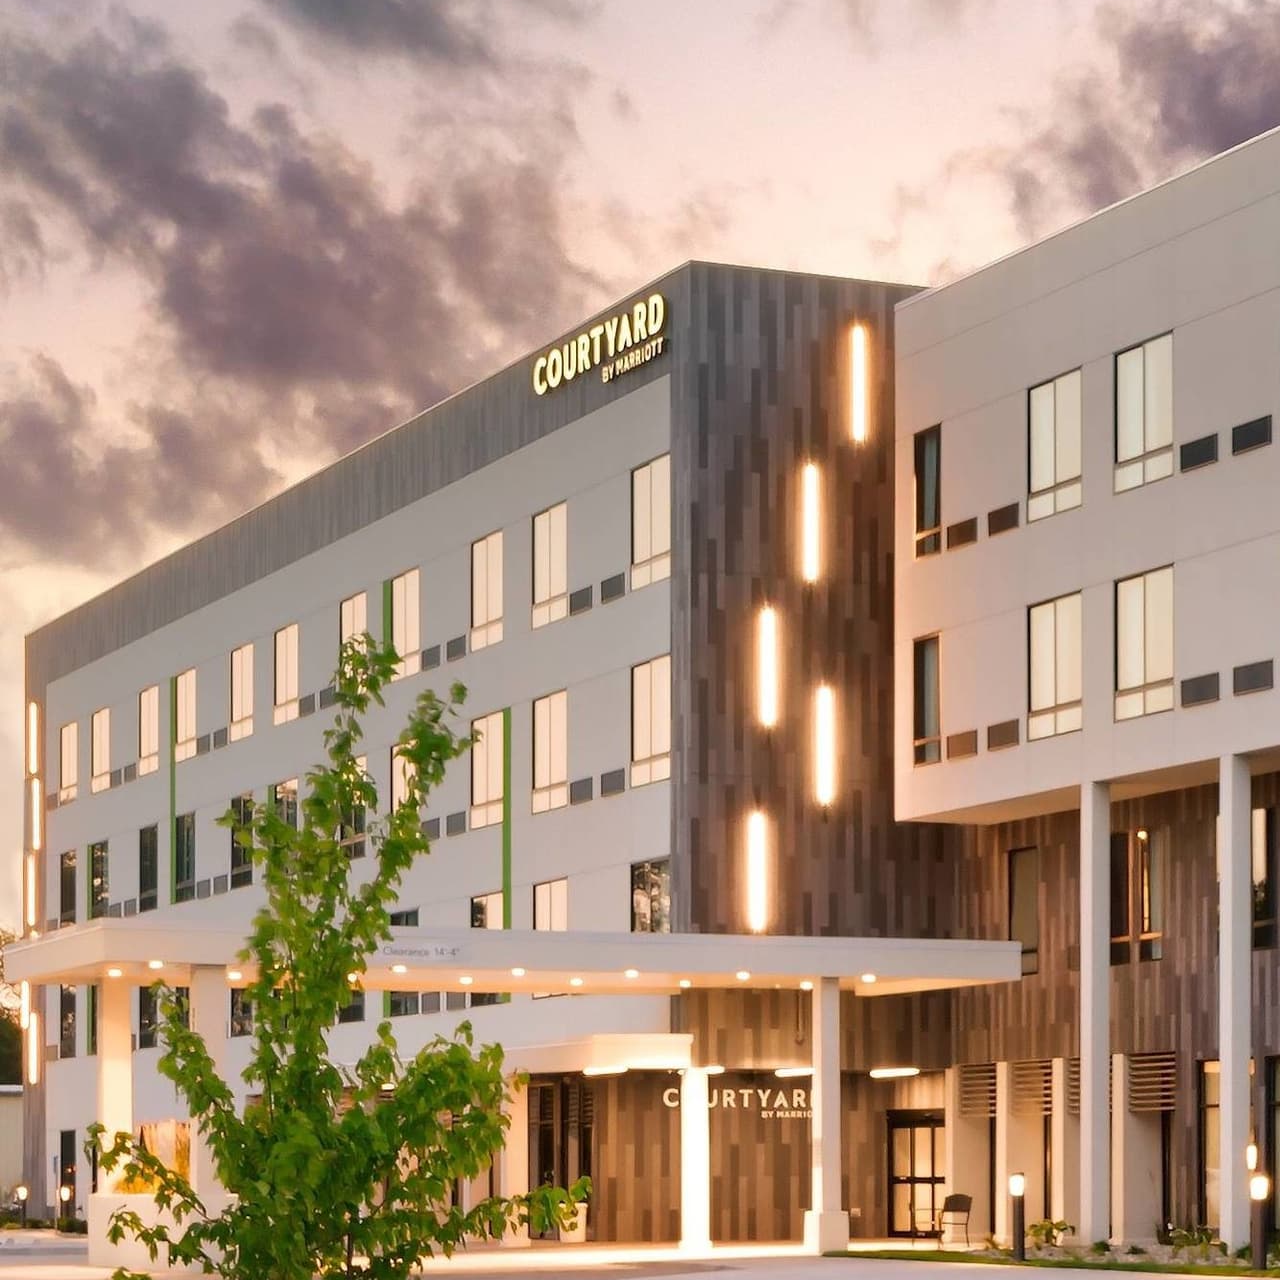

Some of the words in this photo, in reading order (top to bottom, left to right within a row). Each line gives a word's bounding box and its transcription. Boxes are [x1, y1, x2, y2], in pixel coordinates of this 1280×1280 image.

[533, 293, 665, 396] COURTYARD
[602, 363, 616, 384] BY
[615, 336, 664, 377] MARRIOTT
[662, 1087, 814, 1109] CURTYAR
[761, 1110, 774, 1119] BY
[776, 1110, 814, 1119] MARRIO
